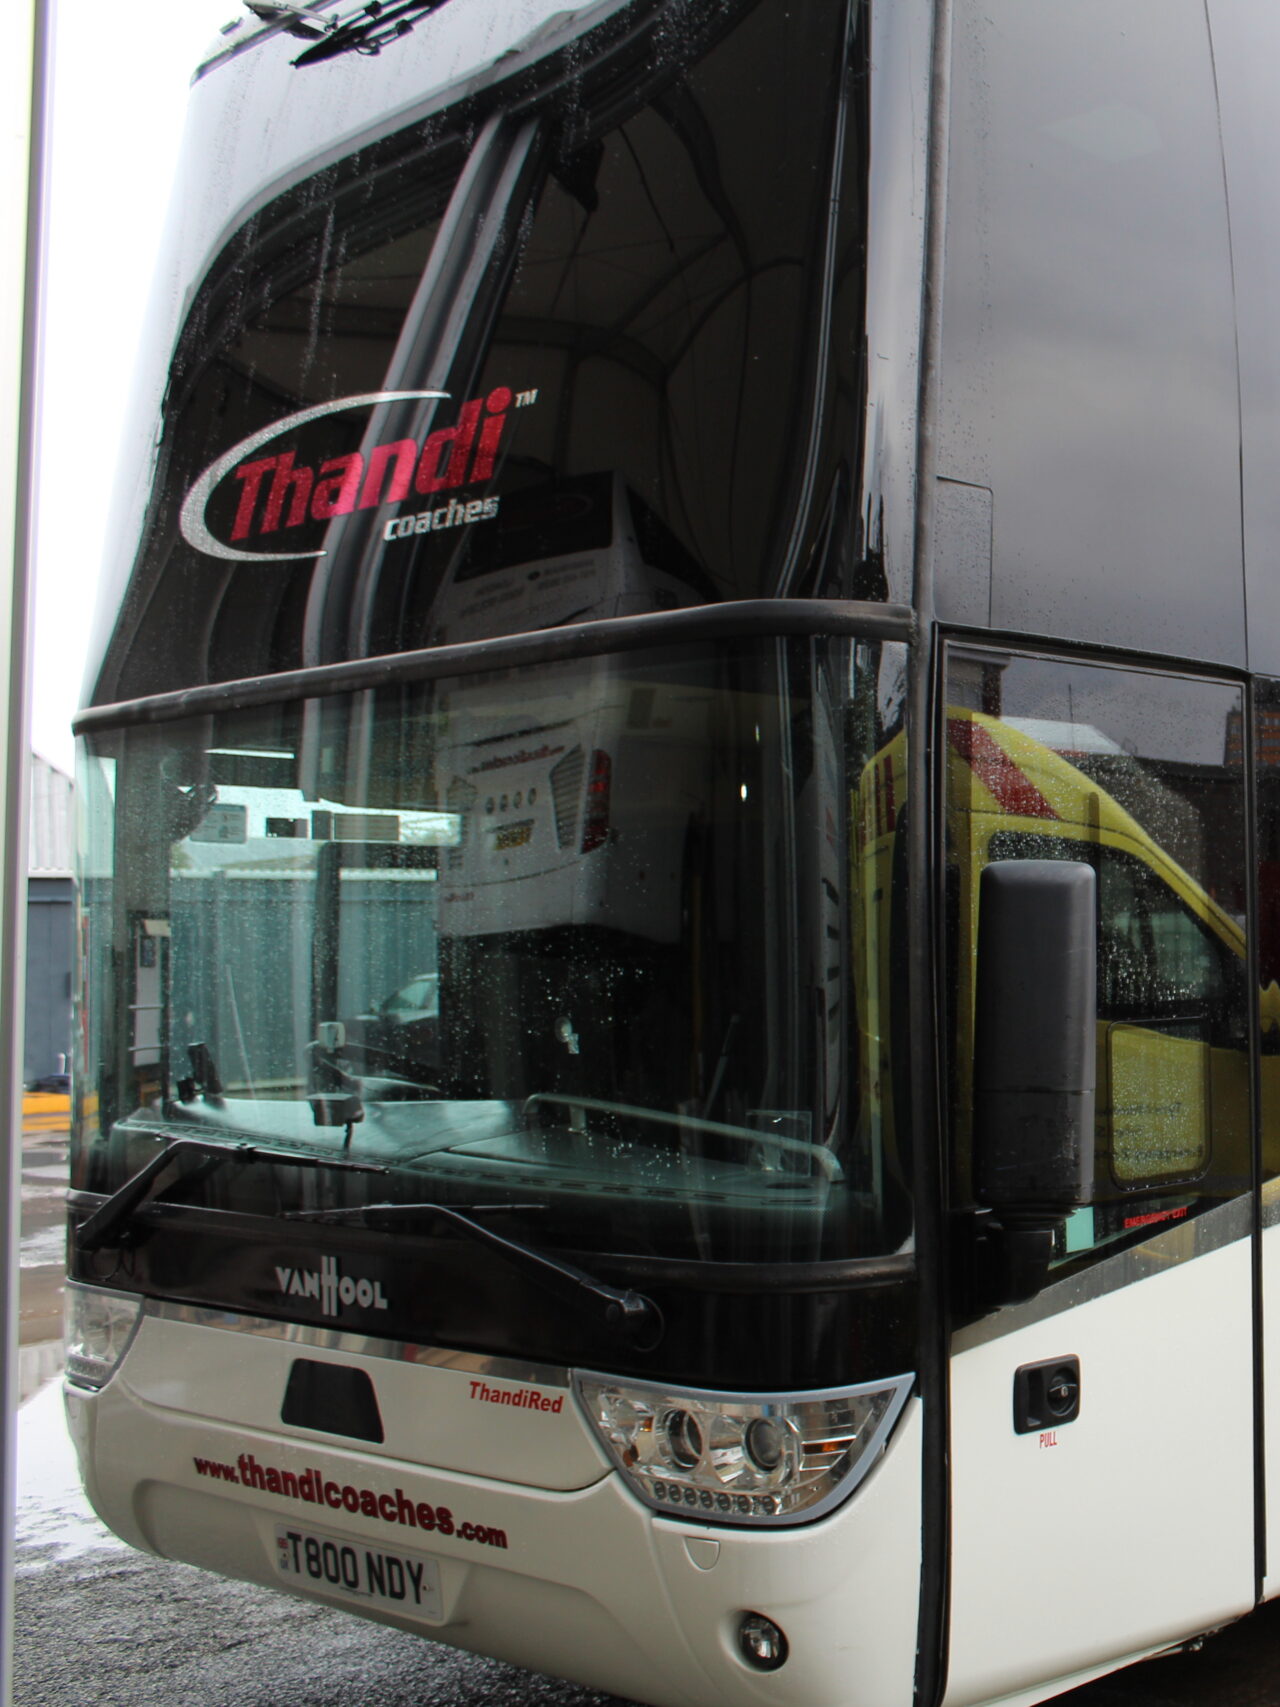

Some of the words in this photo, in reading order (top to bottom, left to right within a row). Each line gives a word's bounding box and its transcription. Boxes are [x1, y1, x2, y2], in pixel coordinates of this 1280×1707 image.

[230, 387, 512, 541] Thandi
[383, 496, 500, 541] coaches
[469, 1381, 565, 1414] ThandiRed
[1039, 1431, 1058, 1449] PULL
[286, 1531, 360, 1589] T800
[366, 1551, 424, 1604] NDY
